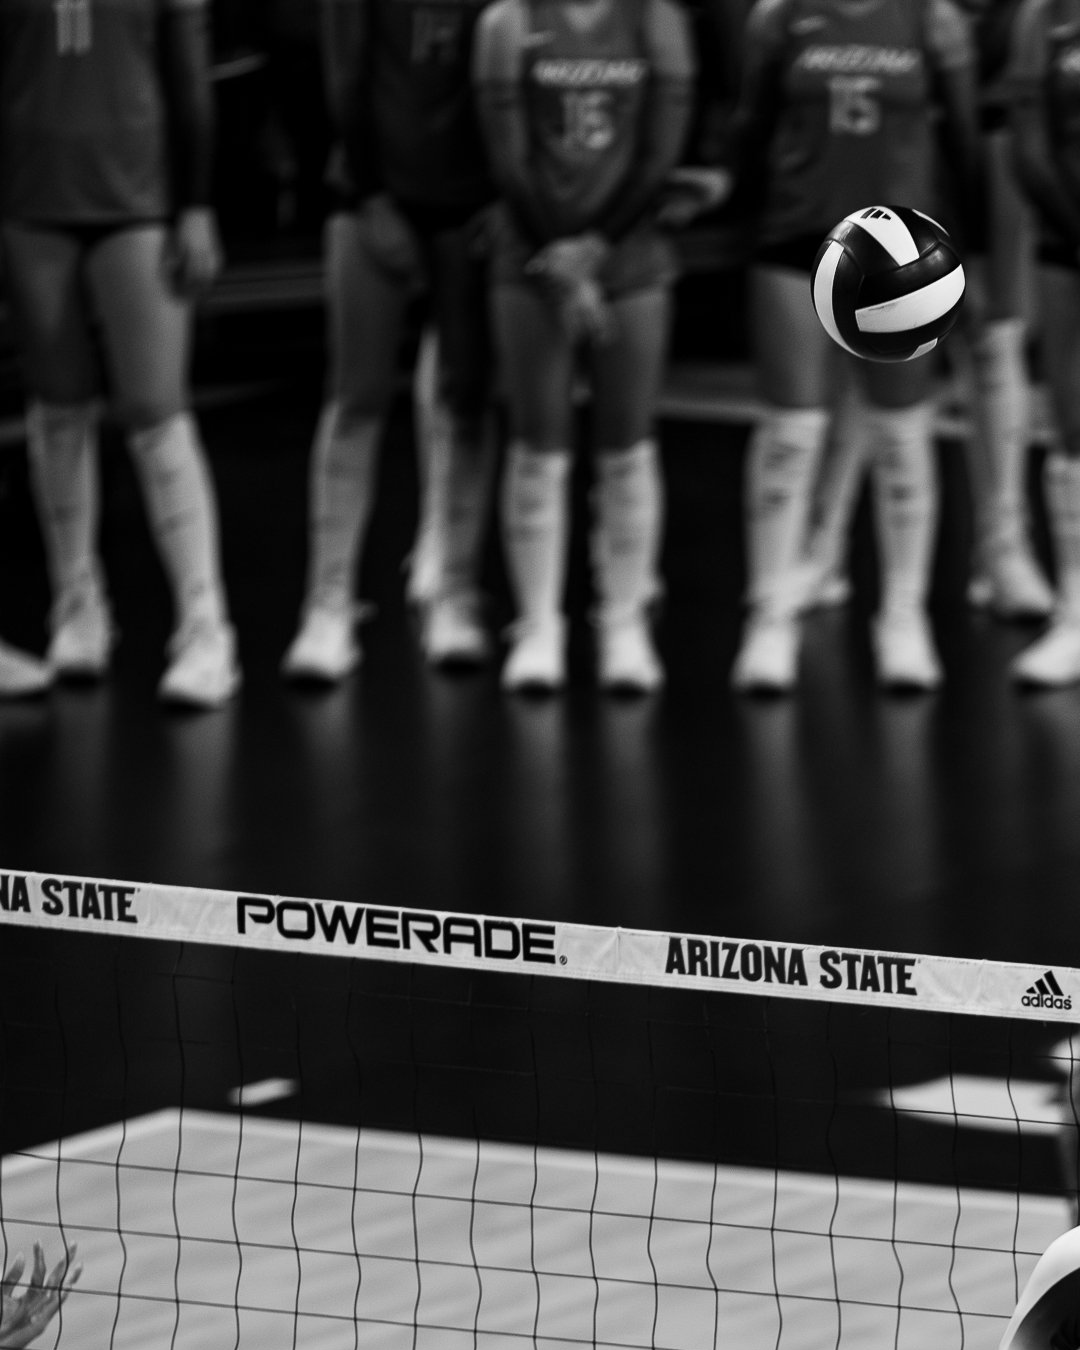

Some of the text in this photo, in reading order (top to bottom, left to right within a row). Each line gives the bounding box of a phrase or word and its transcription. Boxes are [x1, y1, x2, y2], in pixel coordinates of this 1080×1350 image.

[41, 878, 139, 924] STATE
[665, 937, 918, 996] ARIZONA STATE
[1021, 993, 1072, 1010] adidas
